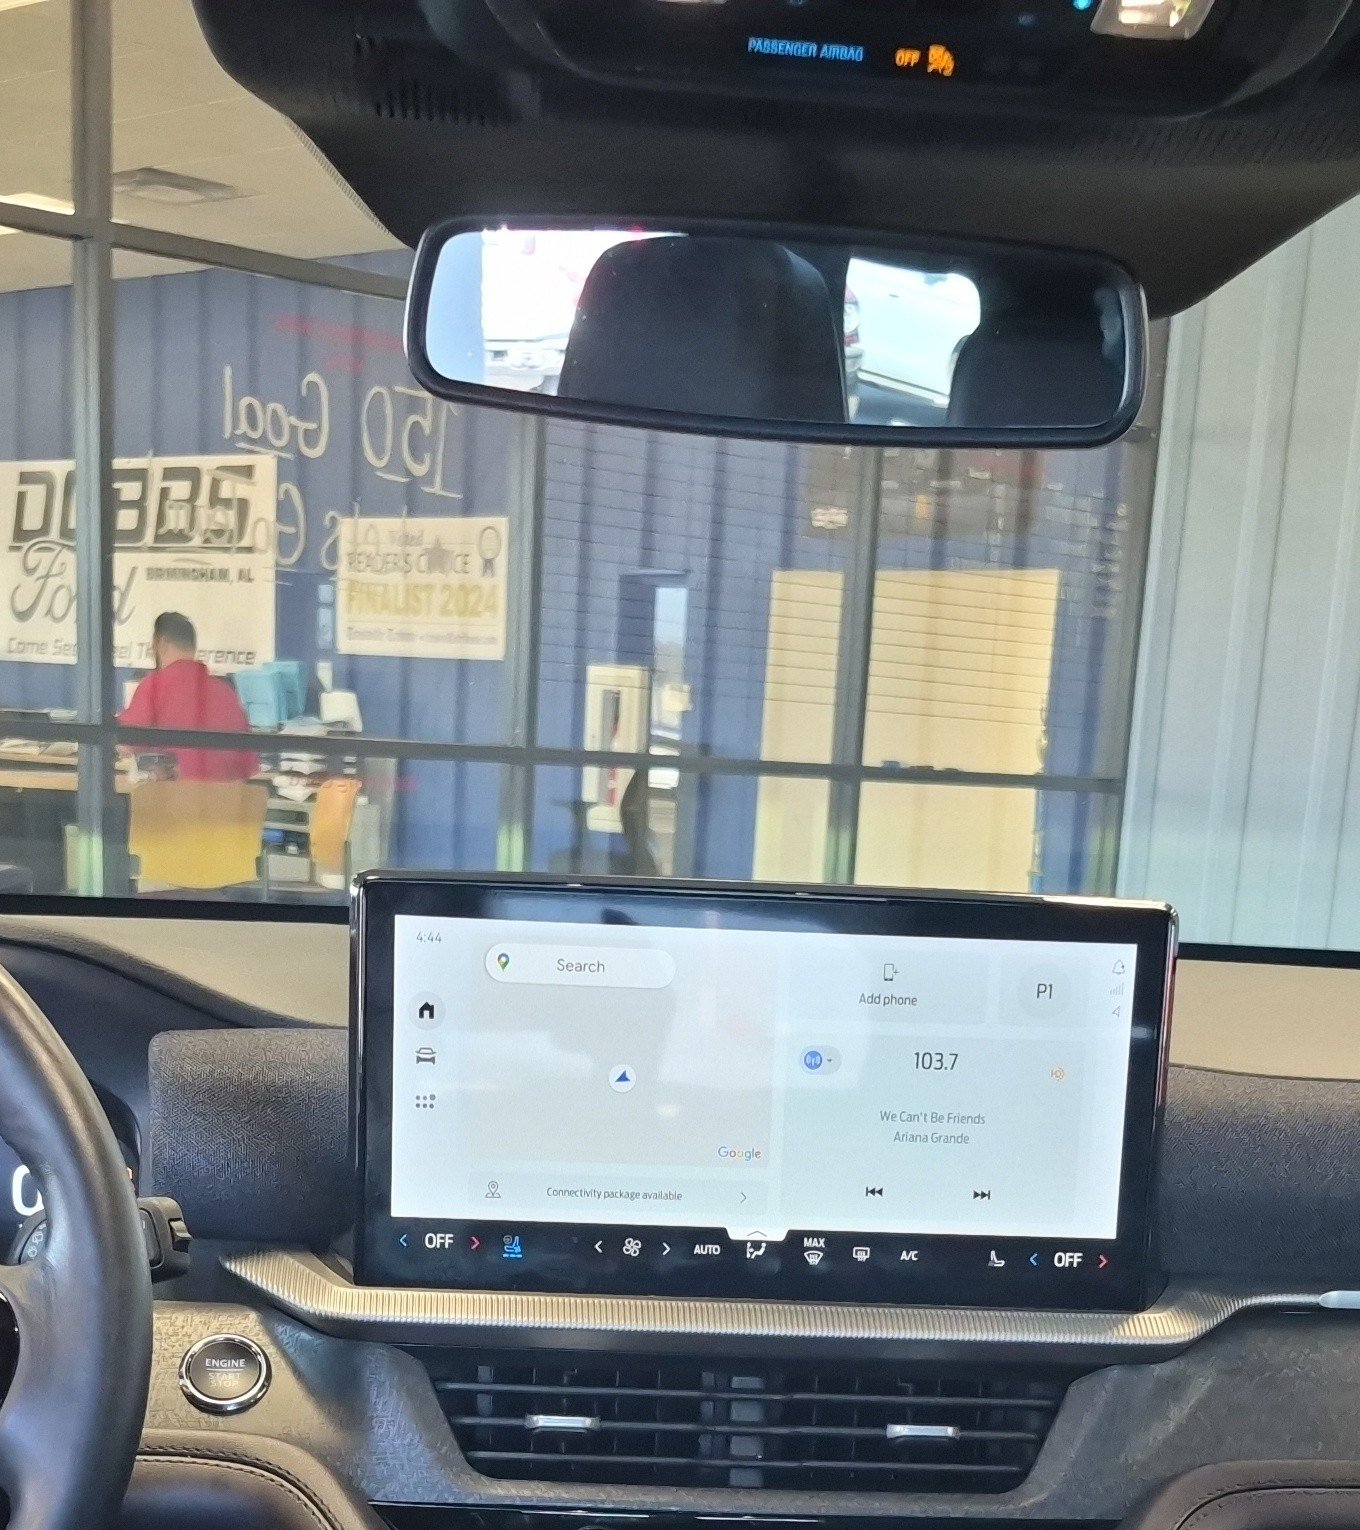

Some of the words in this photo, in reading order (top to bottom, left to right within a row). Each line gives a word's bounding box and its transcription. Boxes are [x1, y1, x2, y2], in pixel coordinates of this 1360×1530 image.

[747, 37, 817, 58] PASSENGER
[819, 44, 864, 62] AIRBAG
[895, 48, 921, 67] OFF
[10, 539, 137, 626] Fod
[416, 931, 443, 944] 4:44
[556, 958, 606, 974] Search
[1035, 982, 1054, 1000] P1
[858, 993, 881, 1006] Add
[882, 994, 918, 1008] phone
[913, 1051, 959, 1071] 103.7
[879, 1110, 897, 1122] We
[899, 1111, 928, 1123] Can't
[930, 1111, 945, 1124] Be
[946, 1112, 986, 1125] Friends
[893, 1131, 929, 1144] Ariana
[930, 1132, 970, 1145] Grande
[717, 1145, 763, 1162] Google
[546, 1186, 602, 1200] Connectivity
[603, 1188, 641, 1202] package
[641, 1189, 683, 1202] available
[424, 1232, 454, 1249] OFF
[803, 1236, 826, 1248] MAX
[693, 1243, 721, 1255] AUTO
[899, 1250, 919, 1261] A/C
[1053, 1251, 1083, 1268] OFF
[204, 1357, 247, 1368] ENGINE
[208, 1371, 242, 1381] START
[210, 1379, 240, 1388] STOP
